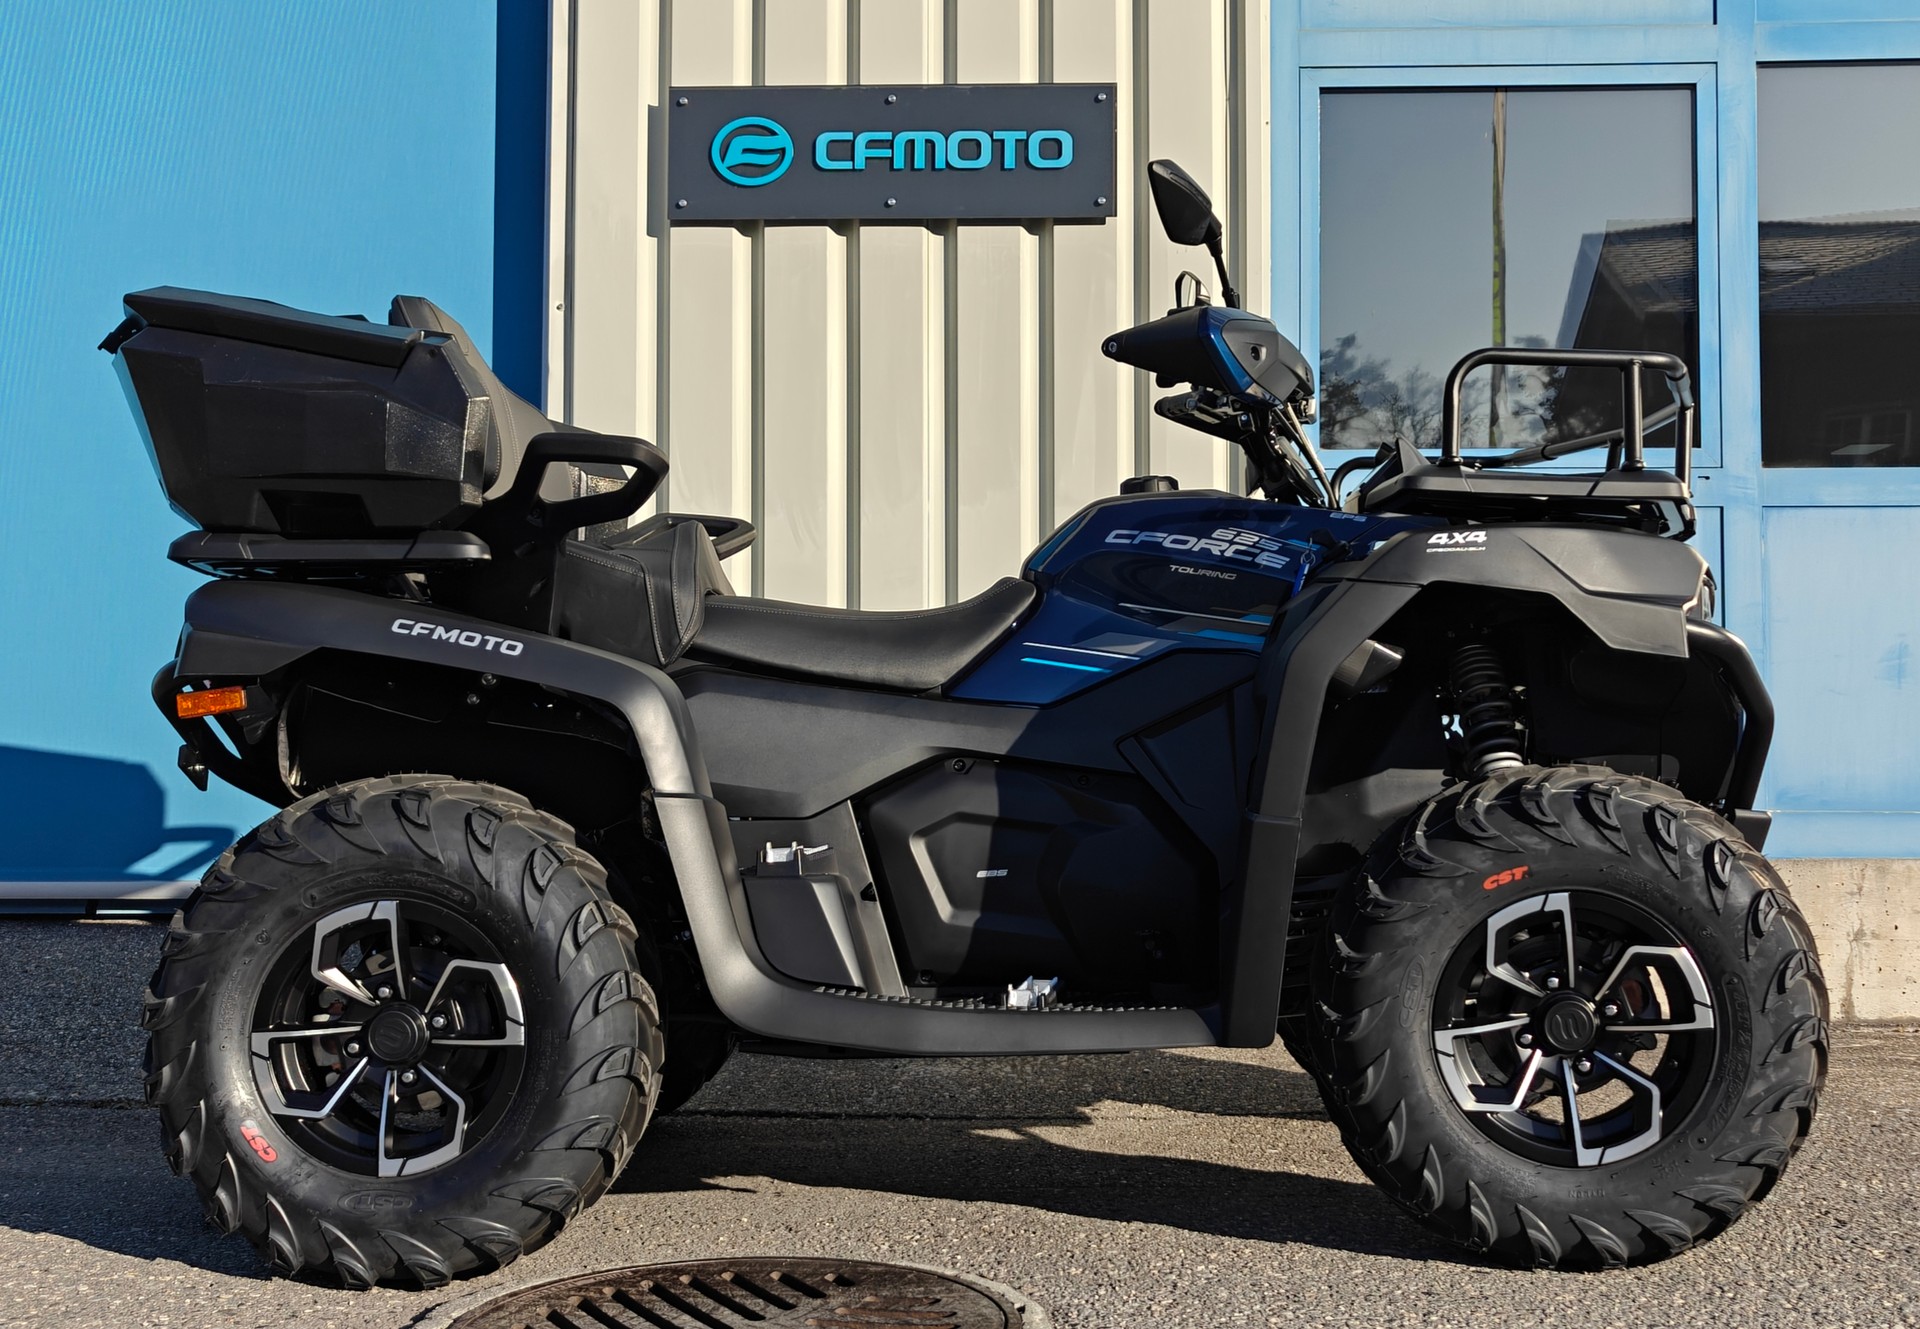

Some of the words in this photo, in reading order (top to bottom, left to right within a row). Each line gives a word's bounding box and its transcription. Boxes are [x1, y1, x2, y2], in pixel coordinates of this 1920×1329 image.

[815, 129, 1075, 171] CFMOTO
[1329, 512, 1368, 523] EPS
[1104, 529, 1291, 569] CFORCE
[1210, 527, 1283, 552] 625
[1169, 563, 1237, 581] TOURING
[391, 619, 524, 656] CFMOTO
[1483, 866, 1528, 891] CST
[240, 1123, 278, 1163] CST
